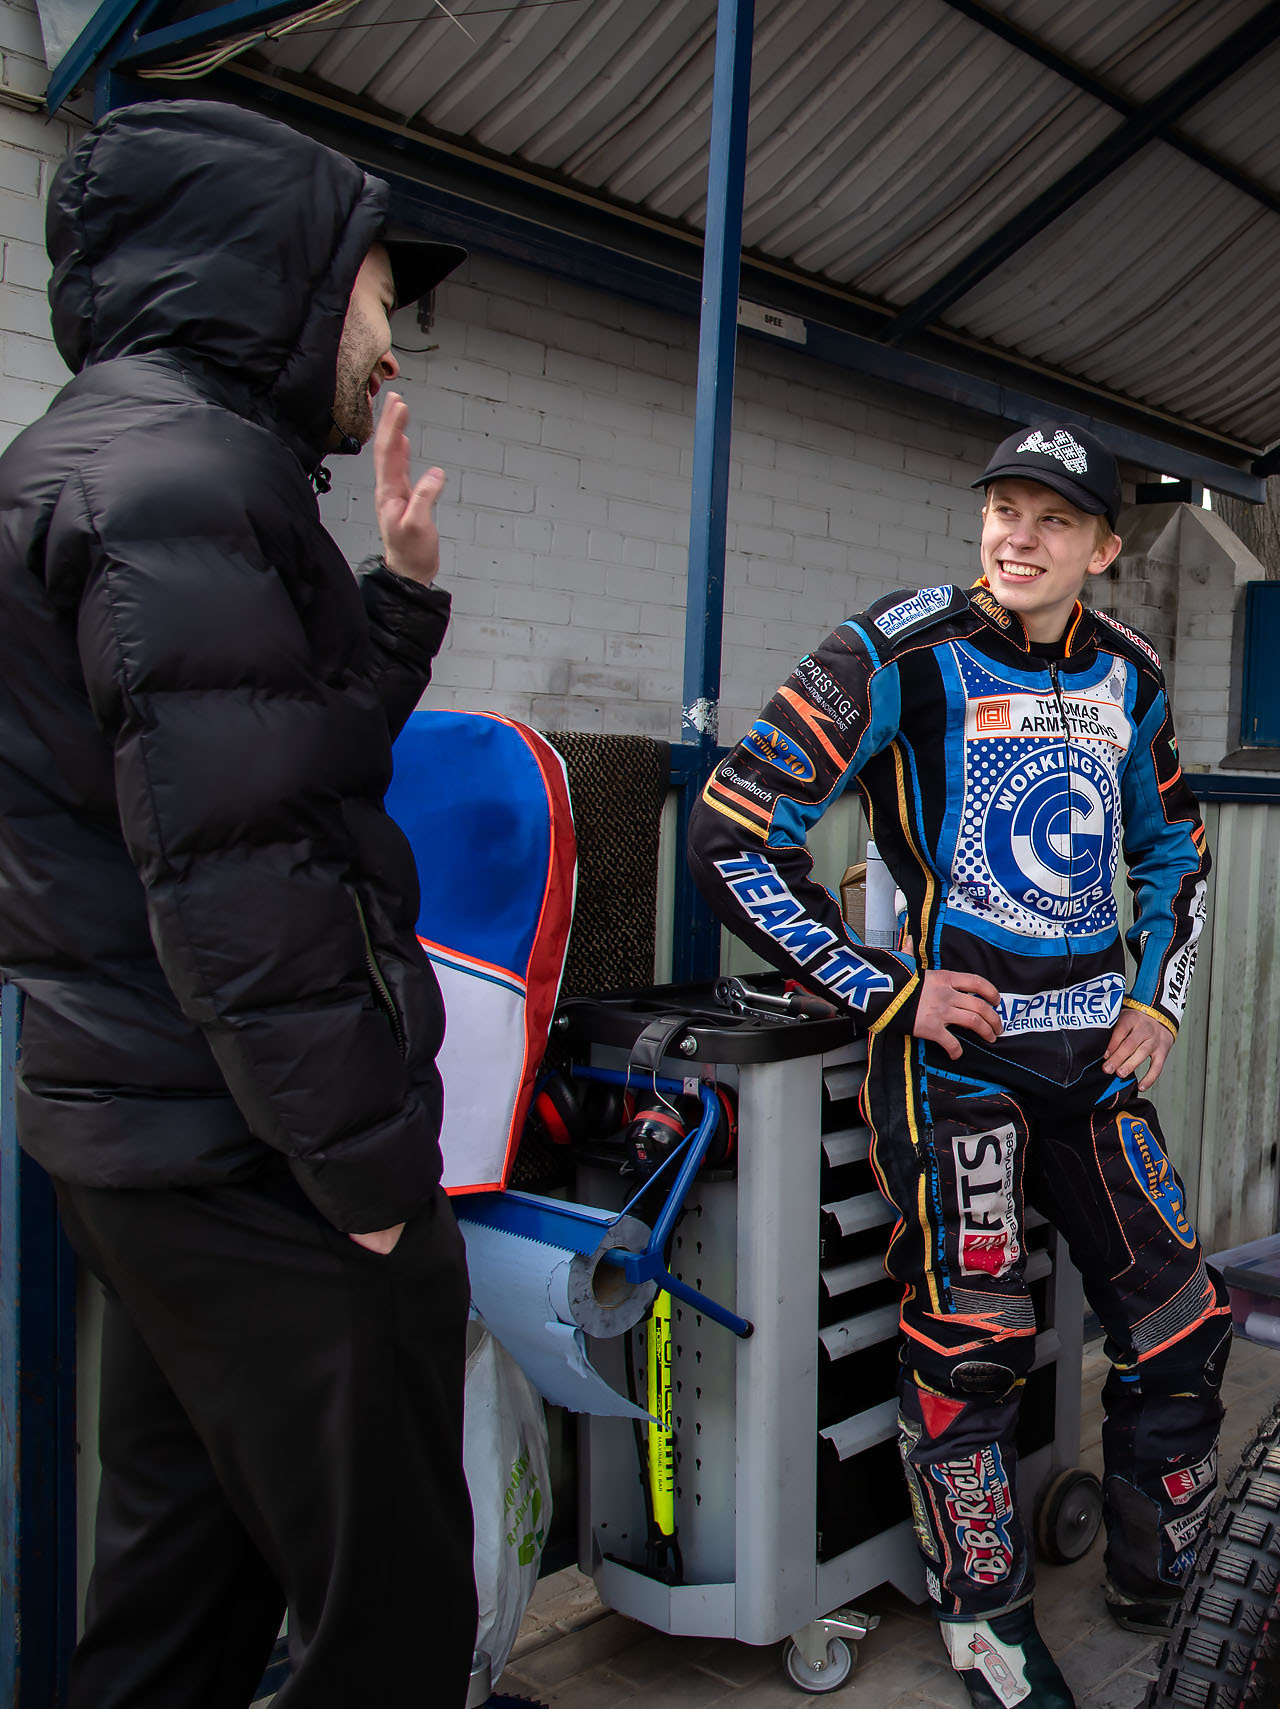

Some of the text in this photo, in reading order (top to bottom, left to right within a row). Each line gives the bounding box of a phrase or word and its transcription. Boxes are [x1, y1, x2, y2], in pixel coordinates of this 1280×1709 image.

[877, 587, 941, 631] SAPPHIRE
[885, 611, 923, 635] ENGINEERING
[795, 668, 848, 732] NSTALLATIONS NORTH EAST
[800, 659, 860, 725] PRESTIGE
[1035, 699, 1100, 721] THOMAS
[747, 729, 778, 761] tering
[1020, 716, 1118, 740] ARMSTRONG
[783, 753, 805, 775] 10
[995, 750, 1113, 813] WORKINGTON
[1022, 885, 1104, 918] COMETS
[713, 851, 838, 967] TEAM
[810, 945, 894, 1013] TK
[992, 991, 1104, 1020] APPHIRE
[1083, 1015, 1108, 1025] LTD
[1004, 1131, 1014, 1190] Services
[1130, 1121, 1165, 1200] Catering
[957, 1135, 1005, 1231] FTS
[989, 1477, 1007, 1519] DURHAM
